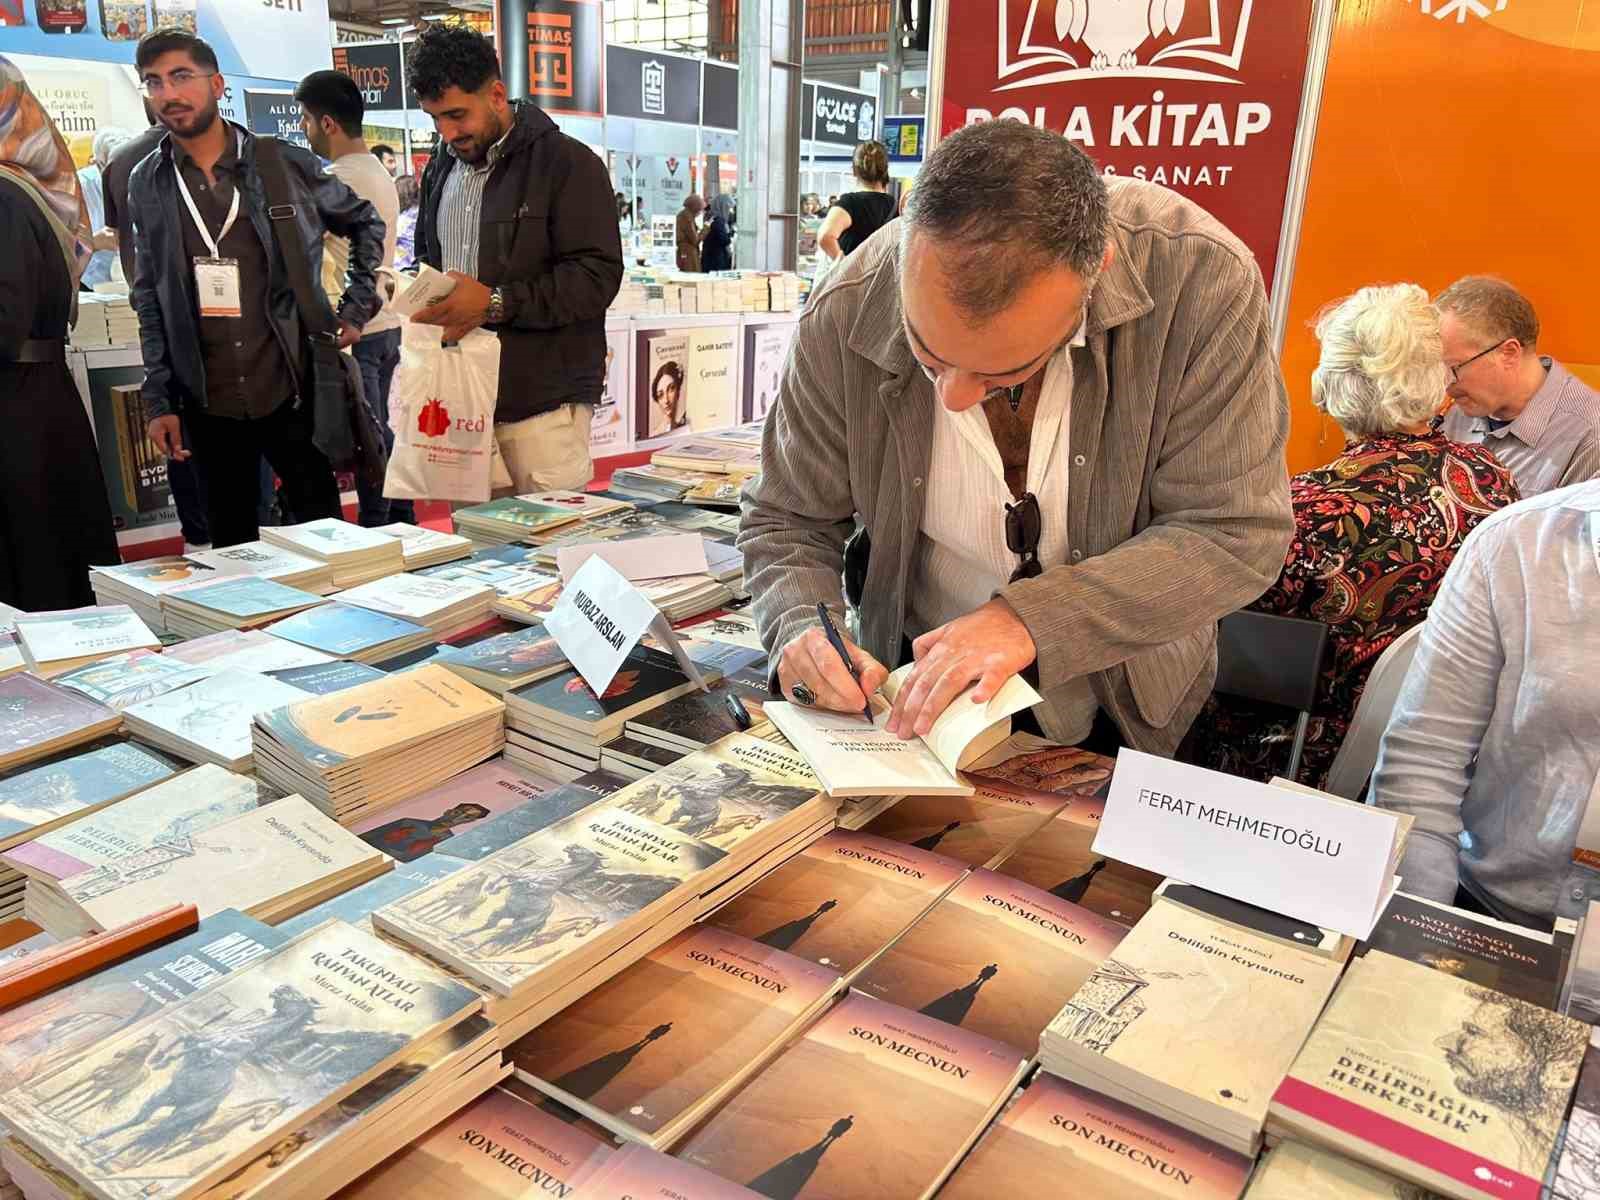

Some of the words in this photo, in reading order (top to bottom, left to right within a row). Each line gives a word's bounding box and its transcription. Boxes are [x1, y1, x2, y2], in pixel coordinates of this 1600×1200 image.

[1110, 90, 1272, 147] KİTAP
[1133, 165, 1233, 186] SANAT
[455, 414, 485, 433] red
[574, 589, 601, 624] MURAZ
[594, 613, 627, 652] ARSLAN
[1137, 788, 1196, 817] FERAT
[1197, 804, 1344, 858] MEHMETOĞLU
[638, 842, 680, 863] ATLAR
[835, 847, 866, 860] SON
[863, 855, 926, 879] MECNUN
[982, 894, 1017, 912] SON
[1014, 908, 1088, 945] MECNUN
[311, 951, 370, 986] RAHVAN
[366, 983, 416, 1013] ATLAR
[340, 947, 422, 995] TAKUNYALI
[686, 950, 719, 967] SON
[717, 961, 788, 994] MECNUN
[1168, 930, 1228, 959] Deliliğin
[1231, 954, 1305, 985] Kıyısında
[344, 993, 376, 1014] Arslan
[848, 1026, 888, 1046] SON
[887, 1041, 970, 1079] MECNUN
[1328, 1069, 1472, 1133] HERKESLİK
[1337, 1056, 1489, 1125] DELİRDİĞİM
[458, 1127, 500, 1155] SON
[492, 1149, 574, 1199] MECNUN
[1049, 1113, 1095, 1140] SON
[1094, 1134, 1194, 1185] MECNUN
